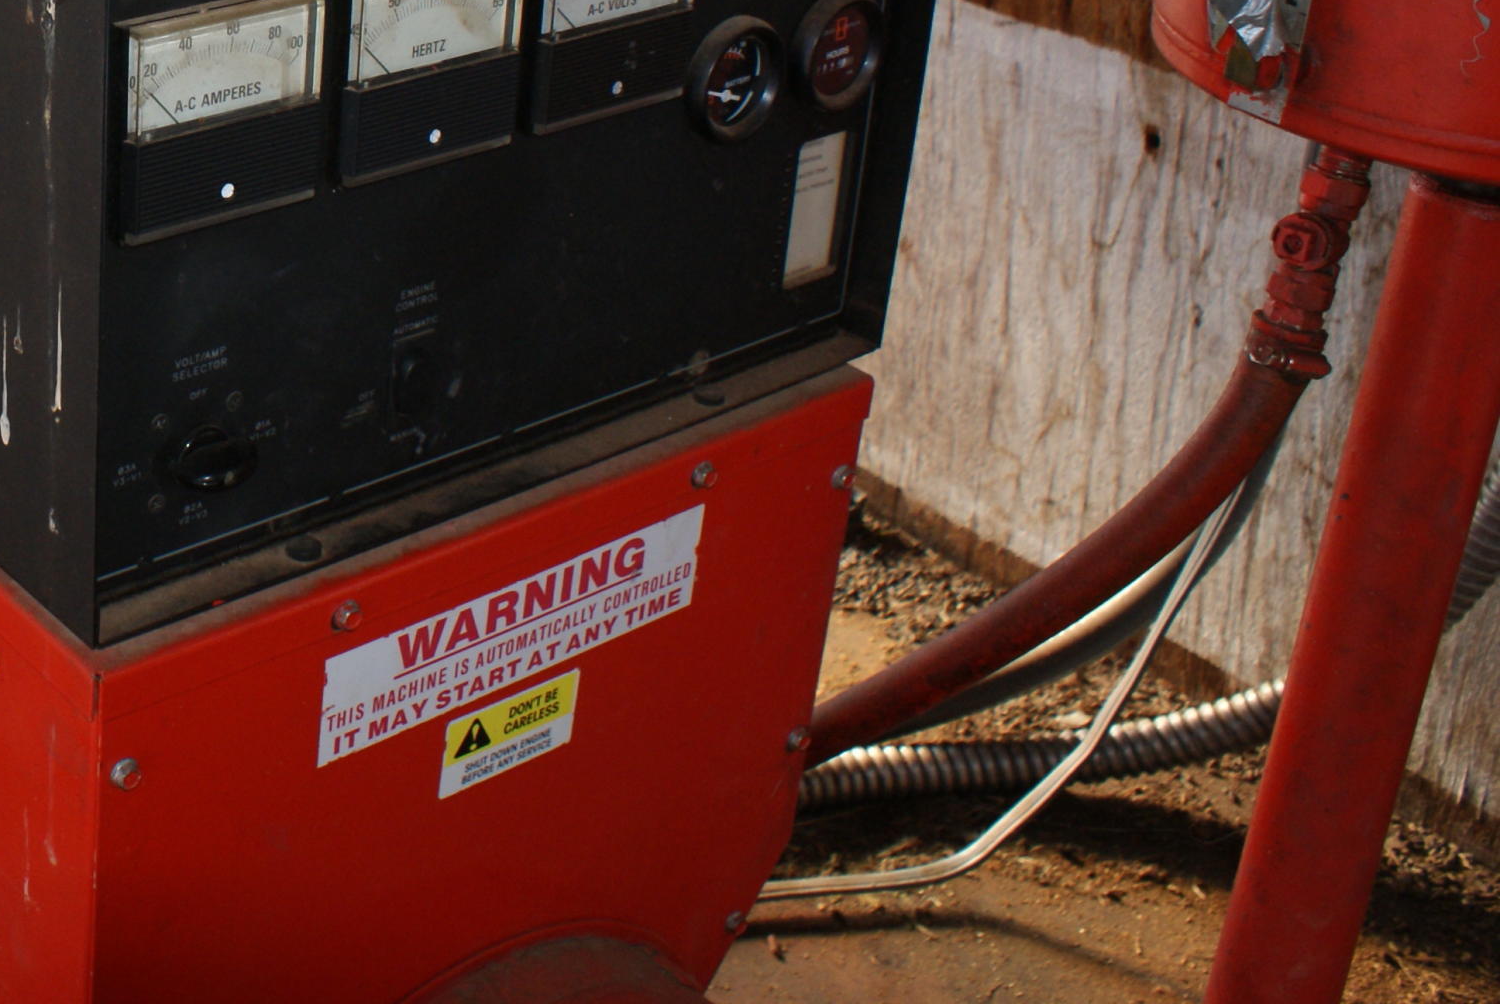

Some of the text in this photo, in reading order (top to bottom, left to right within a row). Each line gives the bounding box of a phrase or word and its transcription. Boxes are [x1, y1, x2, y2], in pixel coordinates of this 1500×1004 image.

[588, 1, 605, 16] A-C
[226, 20, 240, 36] 60
[268, 25, 281, 40] 80
[178, 36, 192, 51] 40
[412, 39, 447, 59] HERTZ
[143, 62, 157, 77] 20
[129, 76, 136, 90] 0
[174, 81, 262, 114] A-C AMPERES
[172, 357, 228, 383] SELECTOR
[174, 345, 228, 370] VOLT/AMP
[397, 537, 645, 669] WARNING
[327, 562, 692, 733] THIS MACHINE IS AUTOMATICALLY CONTROLLED
[333, 587, 682, 755] IT MAY START AT ANY TIME
[508, 687, 559, 719] DON'T BE
[503, 700, 560, 735] CARELESS
[461, 738, 552, 785] BEFORE ANY SERVICE
[464, 727, 551, 773] SHUT DOWN ENGINE
